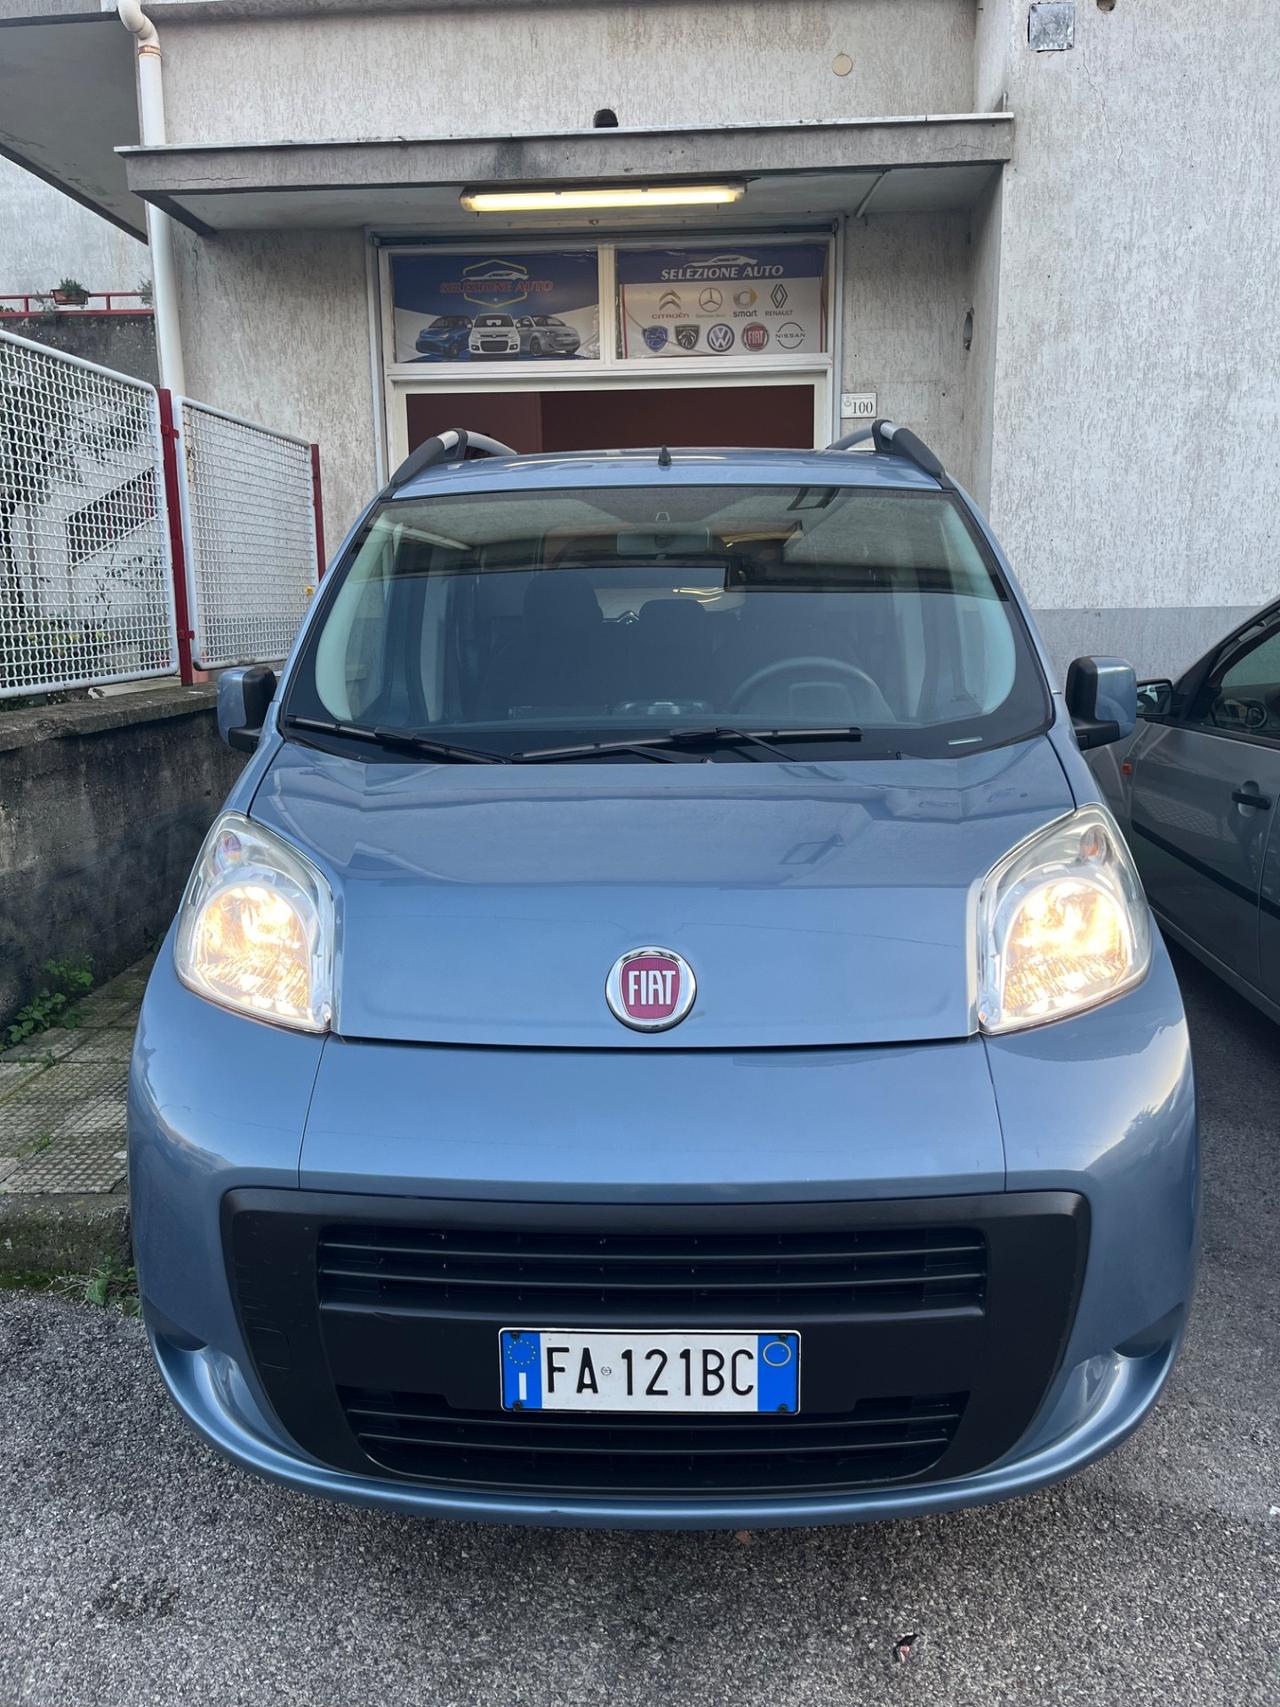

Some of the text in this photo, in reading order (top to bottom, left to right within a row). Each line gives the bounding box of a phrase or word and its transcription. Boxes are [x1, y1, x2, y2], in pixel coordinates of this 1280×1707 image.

[661, 265, 784, 280] SELEZIONE AUTO
[733, 310, 758, 318] smart
[748, 330, 764, 344] FIAT
[853, 401, 873, 414] 100
[628, 970, 676, 1005] FIAT
[546, 1346, 754, 1396] FA 121BC
